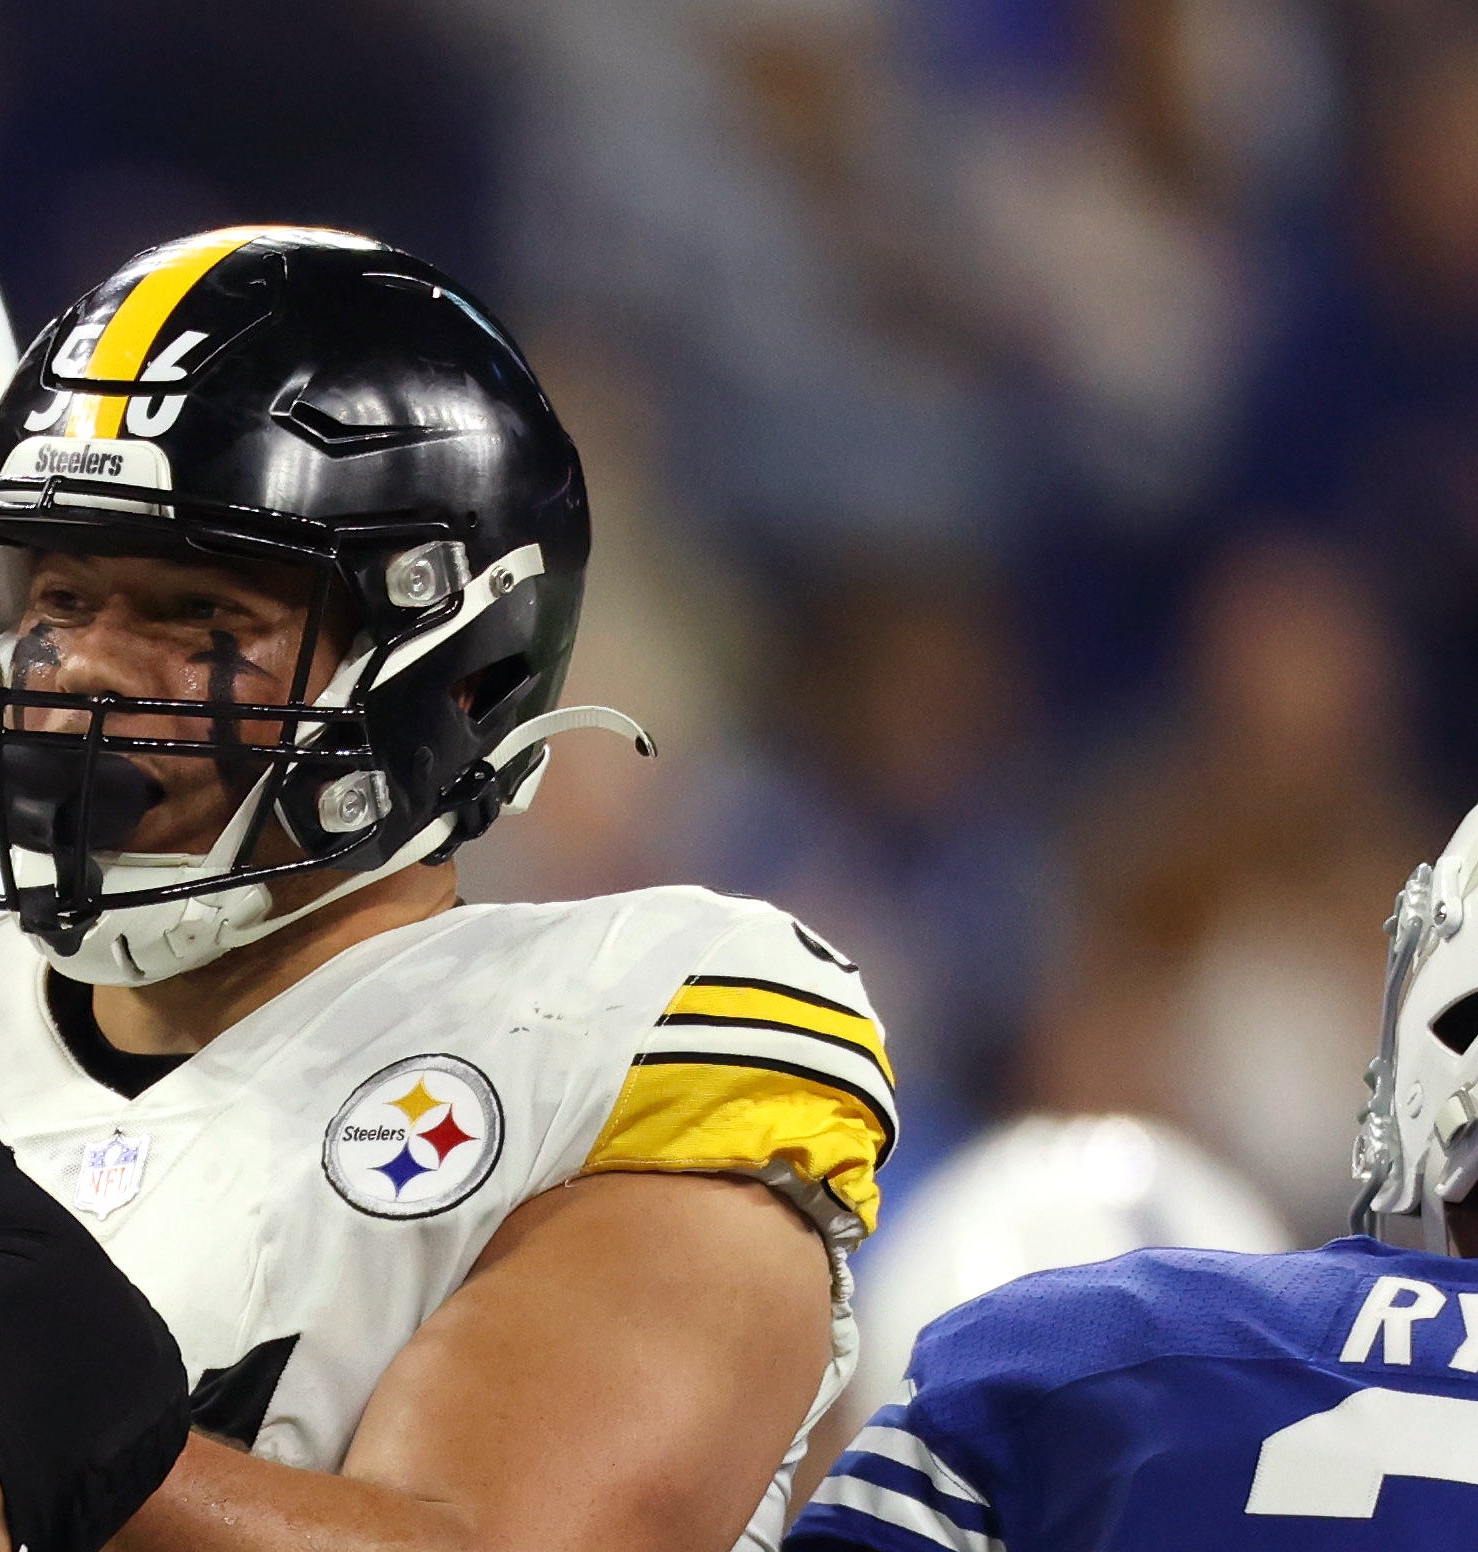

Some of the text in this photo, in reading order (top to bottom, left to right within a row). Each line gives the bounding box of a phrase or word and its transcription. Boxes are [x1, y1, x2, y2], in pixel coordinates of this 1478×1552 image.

[23, 324, 210, 438] 56
[35, 445, 124, 477] Steelers
[342, 1124, 406, 1142] Steelers
